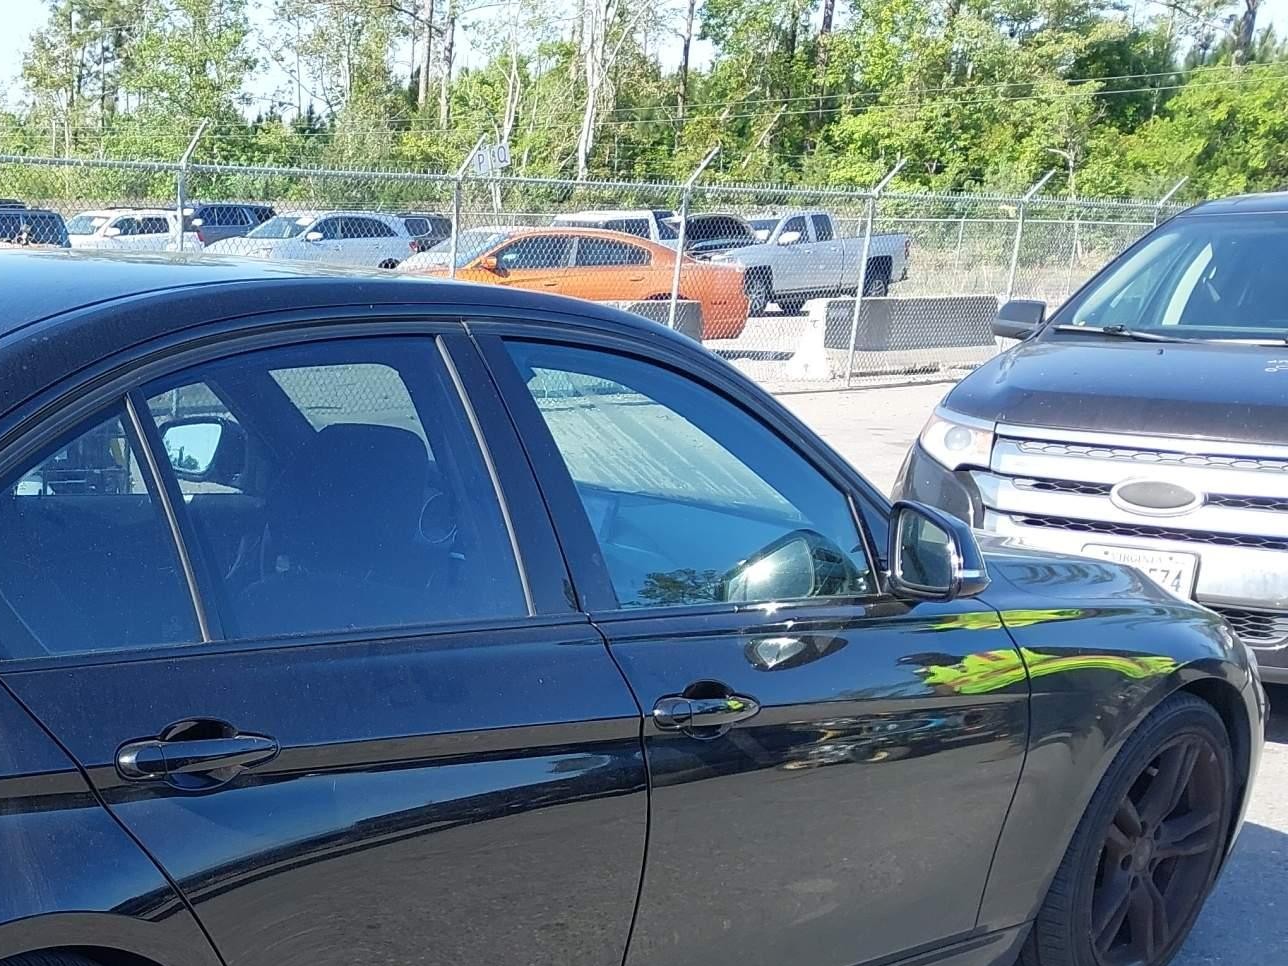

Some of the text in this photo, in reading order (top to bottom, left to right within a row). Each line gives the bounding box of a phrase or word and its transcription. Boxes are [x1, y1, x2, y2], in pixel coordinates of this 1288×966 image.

[478, 145, 509, 171] P Q
[1111, 551, 1164, 564] VIRGINIA
